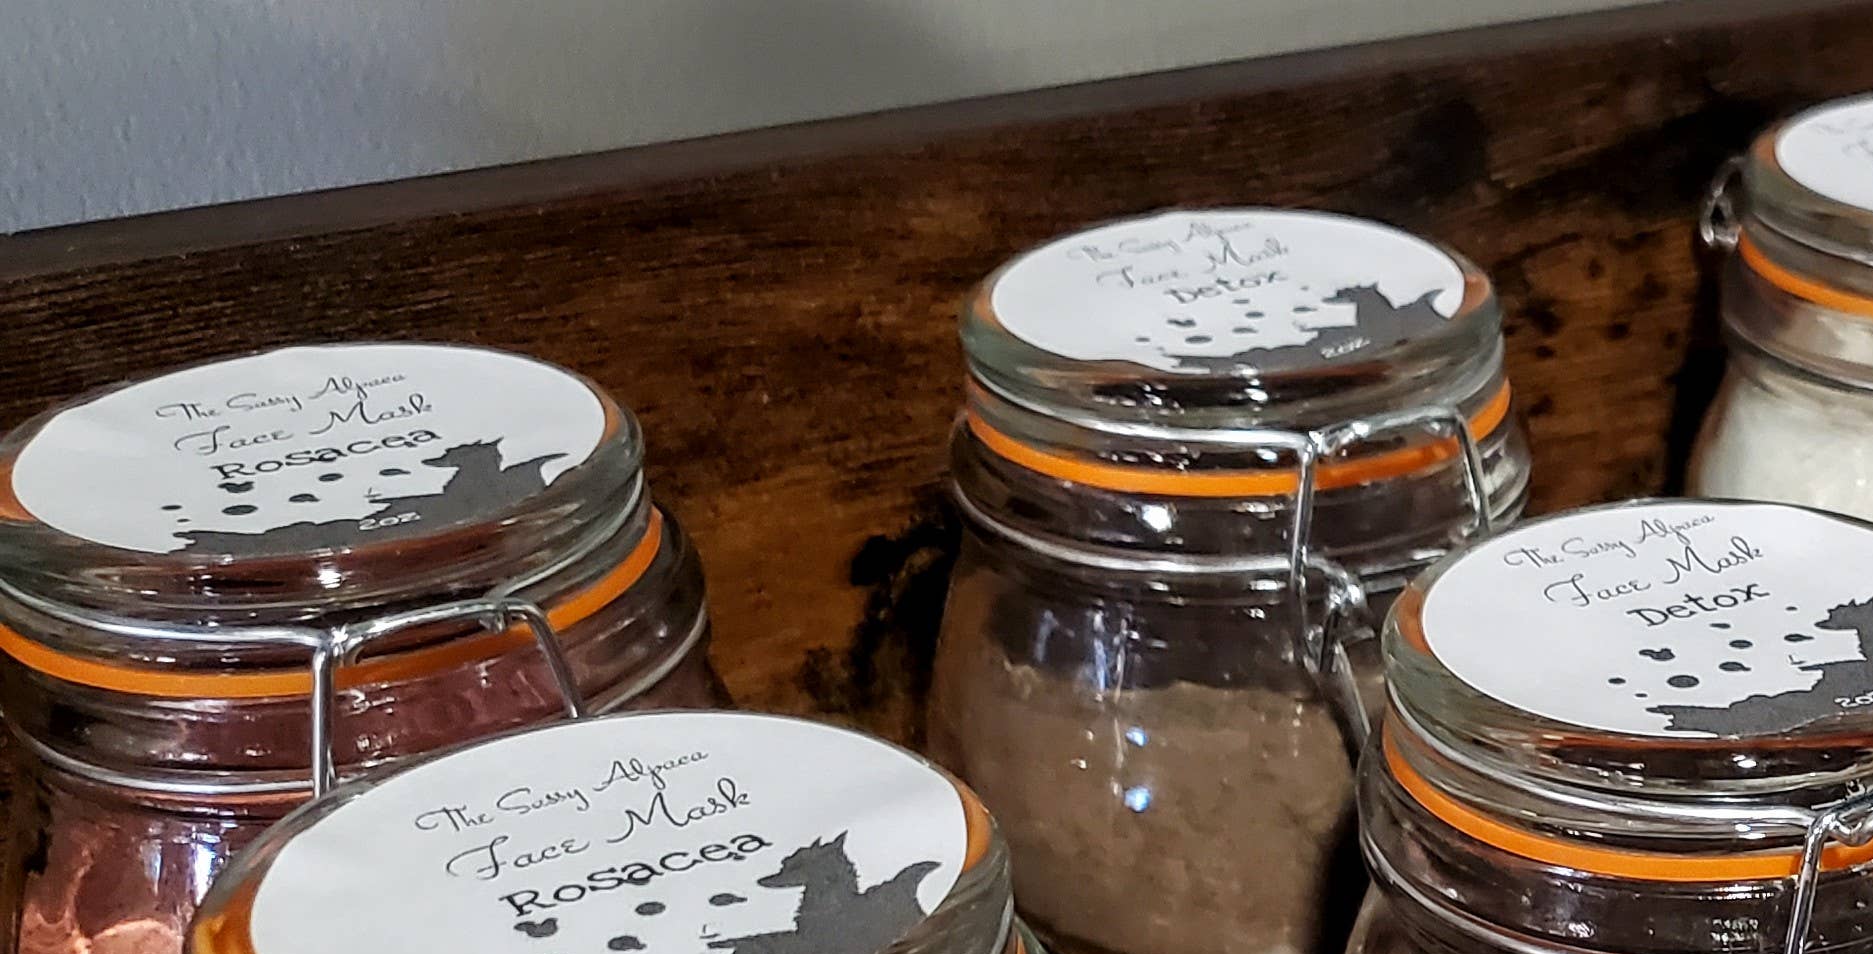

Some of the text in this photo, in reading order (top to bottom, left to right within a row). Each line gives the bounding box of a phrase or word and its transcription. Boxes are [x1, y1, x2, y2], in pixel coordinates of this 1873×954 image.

[1163, 271, 1288, 304] Detox
[155, 375, 406, 421] The Sassy Alpaca
[173, 393, 432, 456] Face Mask
[210, 429, 442, 480] Rosacea
[358, 511, 422, 531] 2oz
[1503, 513, 1716, 568] The Sassy Alpaca
[1543, 535, 1765, 608] Face Mask
[1626, 582, 1771, 627] Detox
[414, 750, 711, 833] The Sassy Alpaca
[446, 777, 751, 881] Face Mask
[498, 833, 774, 918] Rosacea
